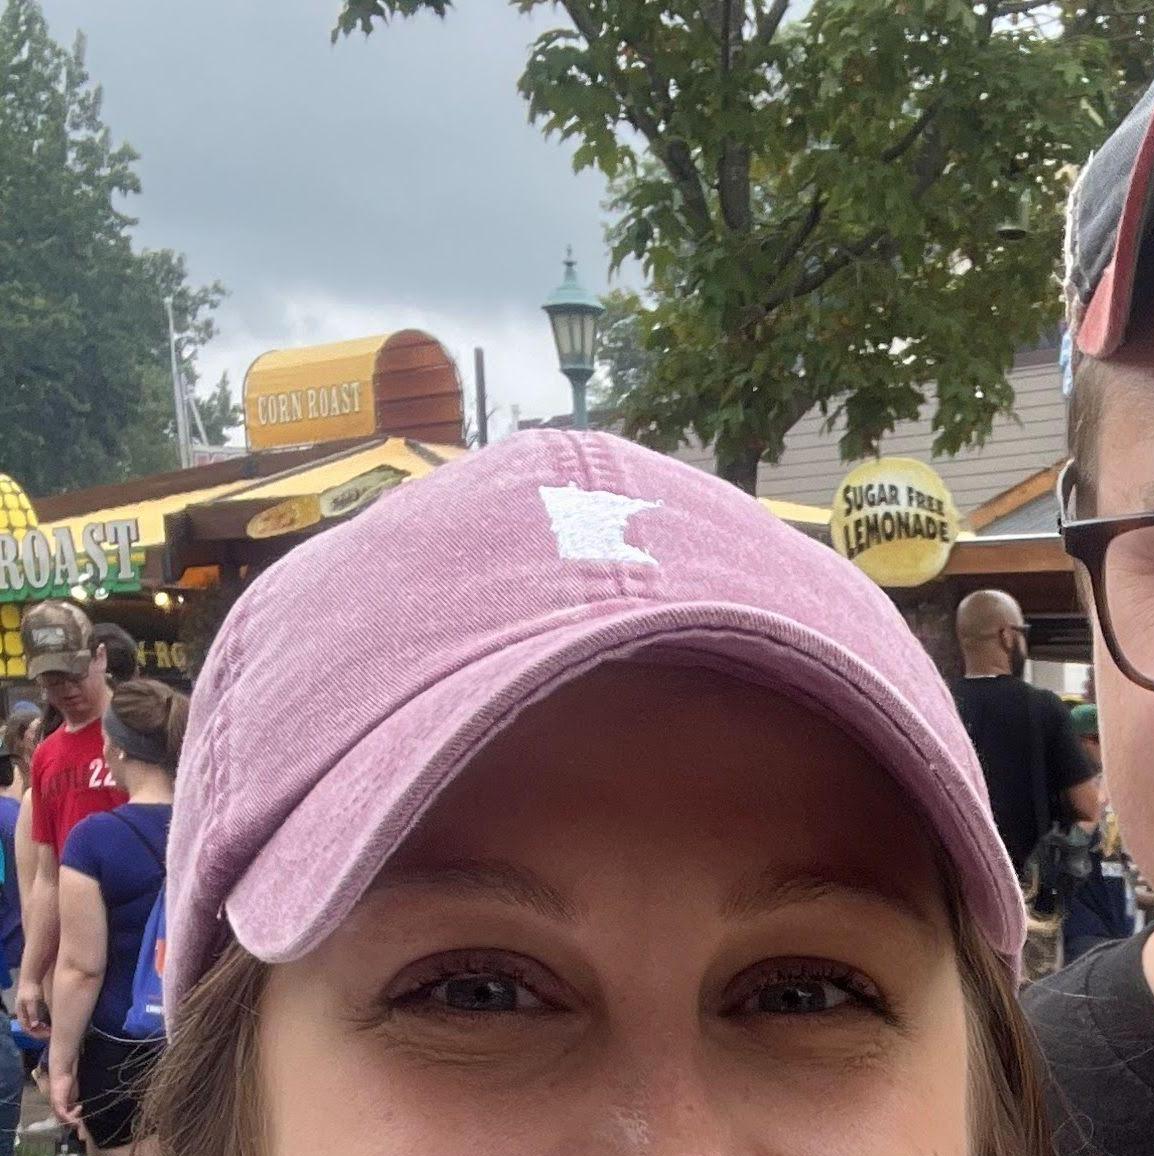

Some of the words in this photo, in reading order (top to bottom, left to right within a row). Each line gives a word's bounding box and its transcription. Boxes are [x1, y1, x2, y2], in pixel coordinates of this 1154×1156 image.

[257, 390, 303, 425] CORN
[307, 381, 360, 419] ROAST
[843, 483, 900, 517] SUGAR
[907, 486, 945, 517] FREE
[0, 519, 139, 591] ROAST
[844, 511, 950, 560] LEMONADE
